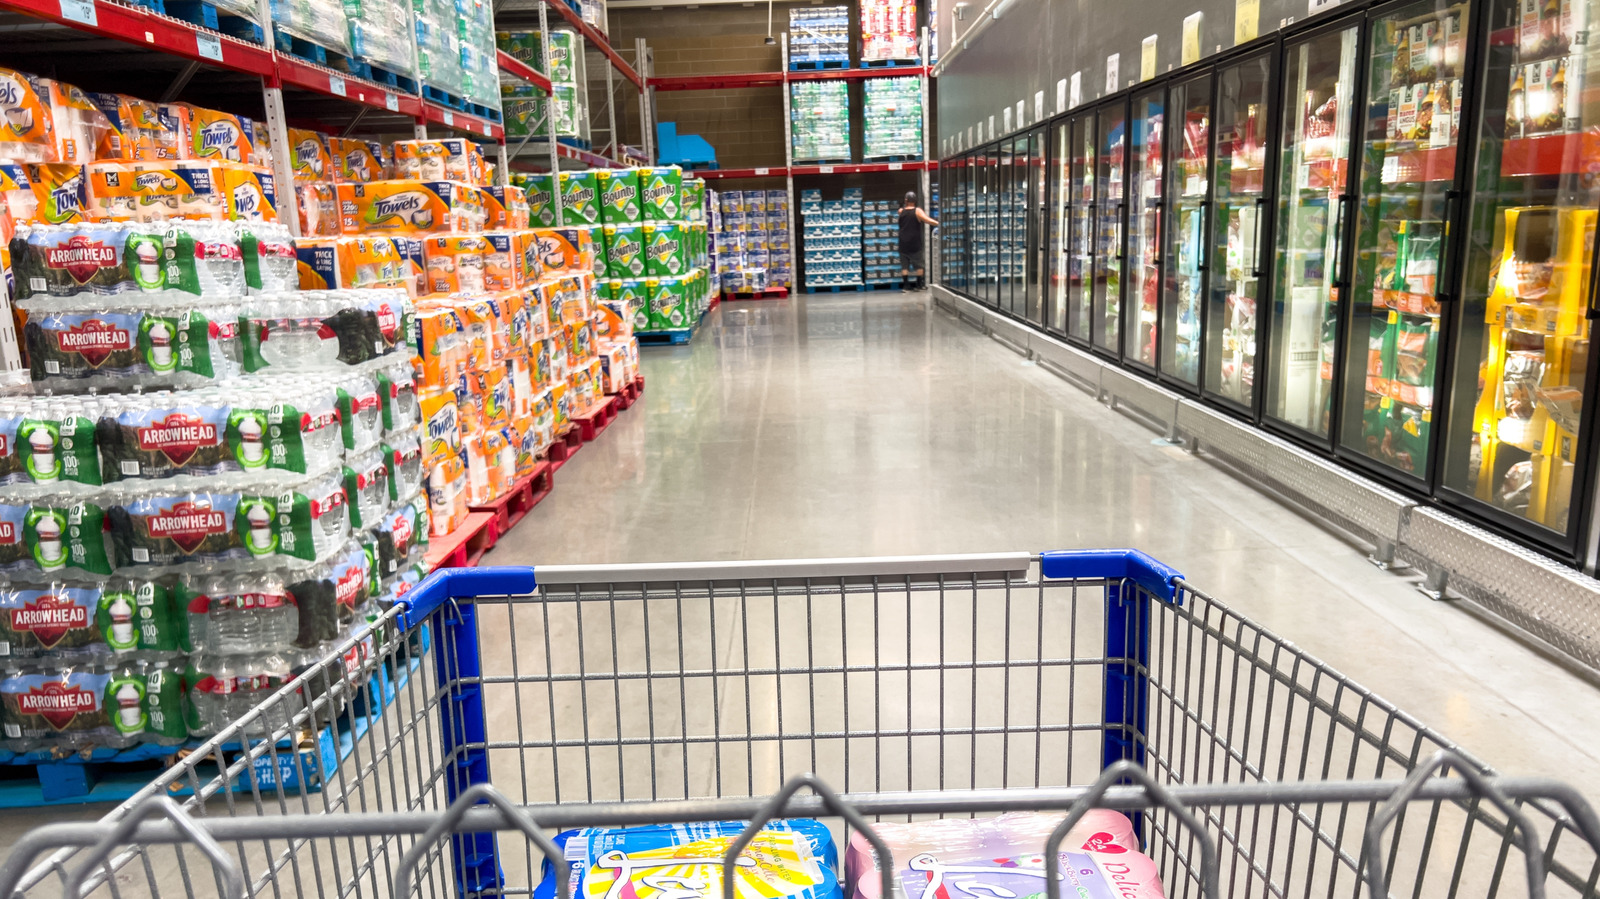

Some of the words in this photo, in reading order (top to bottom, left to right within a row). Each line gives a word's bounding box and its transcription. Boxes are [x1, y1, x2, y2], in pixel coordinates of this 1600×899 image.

[506, 101, 536, 119] Bounty
[1400, 116, 1415, 124] ANGUS
[201, 128, 233, 148] Towels
[136, 175, 160, 186] Towels
[562, 188, 594, 209] Bounty
[602, 186, 636, 207] Bounty
[643, 184, 676, 204] Bounty
[374, 197, 419, 219] Towels
[344, 218, 353, 226] 15
[50, 248, 114, 263] ARROWHEAD
[315, 251, 332, 259] THICK
[608, 242, 640, 263] Bounty
[646, 240, 679, 260] Bounty
[486, 276, 494, 285] 15
[650, 294, 681, 314] Bounty
[63, 331, 126, 346] ARROWHEAD
[428, 410, 455, 439] Towels
[144, 426, 214, 444] ARROWHEAD
[152, 513, 223, 531] ARROWHEAD
[138, 584, 151, 597] 40
[16, 608, 84, 625] ARROWHEAD
[24, 693, 92, 709] ARROWHEAD
[255, 767, 292, 784] CHP
[1092, 838, 1108, 850] 24
[1080, 868, 1094, 876] 6
[1102, 862, 1141, 899] Delic
